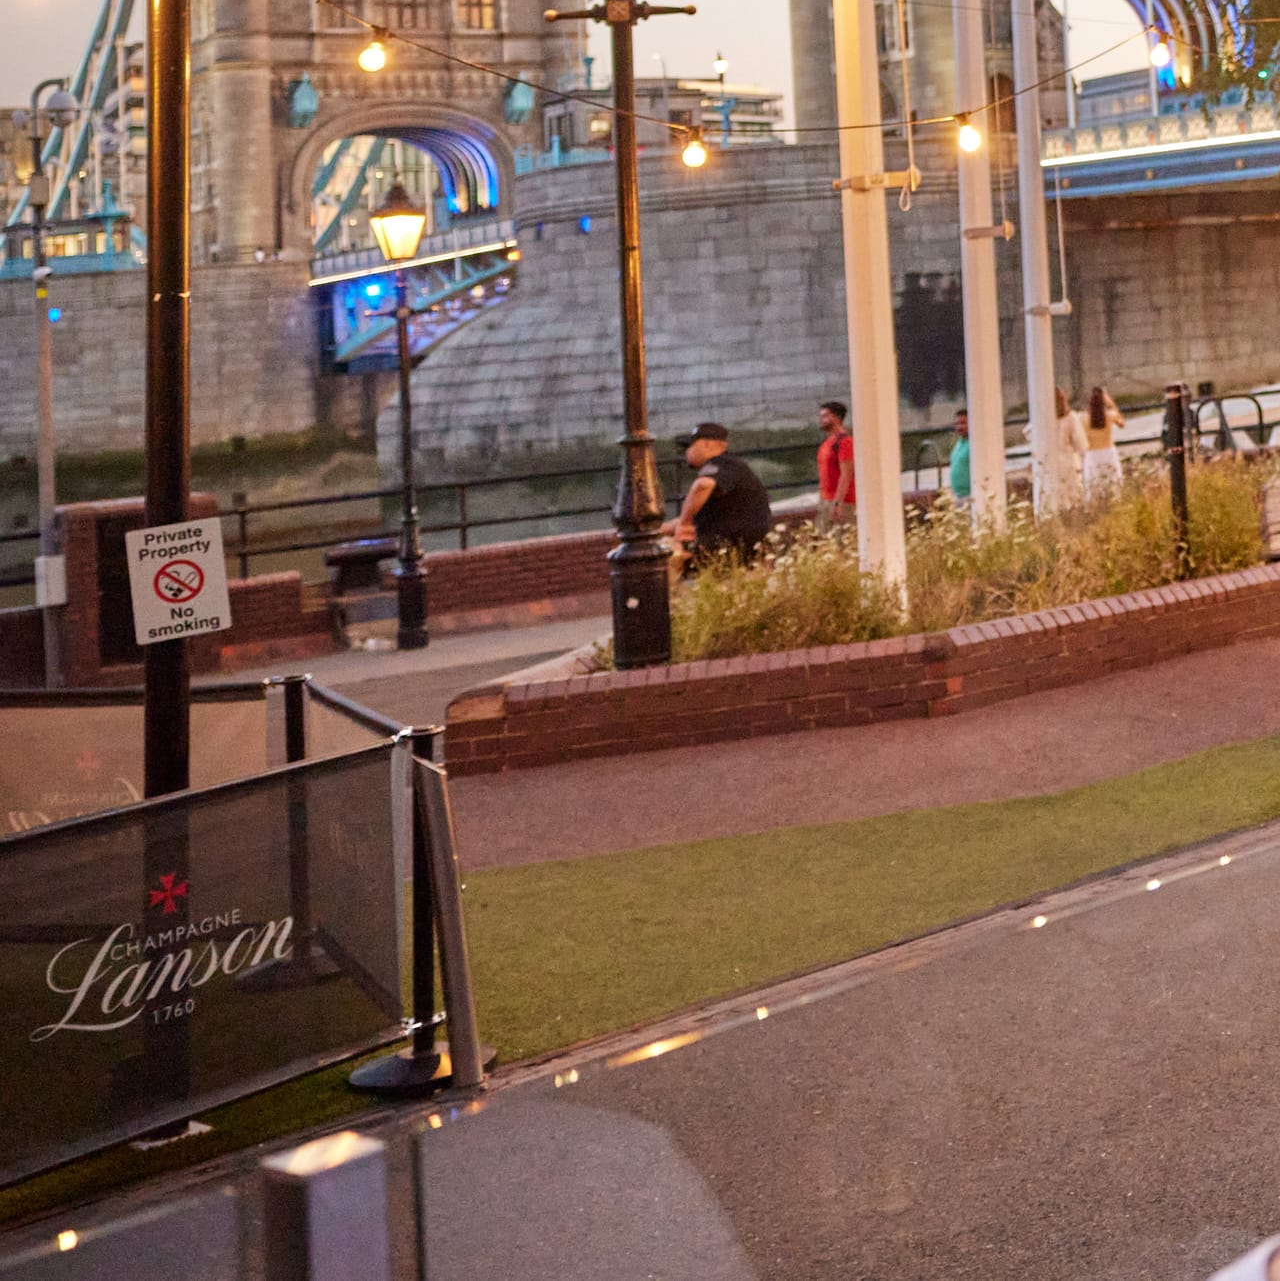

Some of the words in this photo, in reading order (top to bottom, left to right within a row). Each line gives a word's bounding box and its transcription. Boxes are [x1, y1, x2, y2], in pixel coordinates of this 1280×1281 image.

[144, 527, 203, 546] Private
[138, 540, 211, 561] Property
[170, 607, 194, 620] No
[148, 616, 220, 639] smoking
[110, 908, 242, 961] CHAMPAGNE
[29, 916, 294, 1043] Lanson
[152, 998, 196, 1024] 1760
